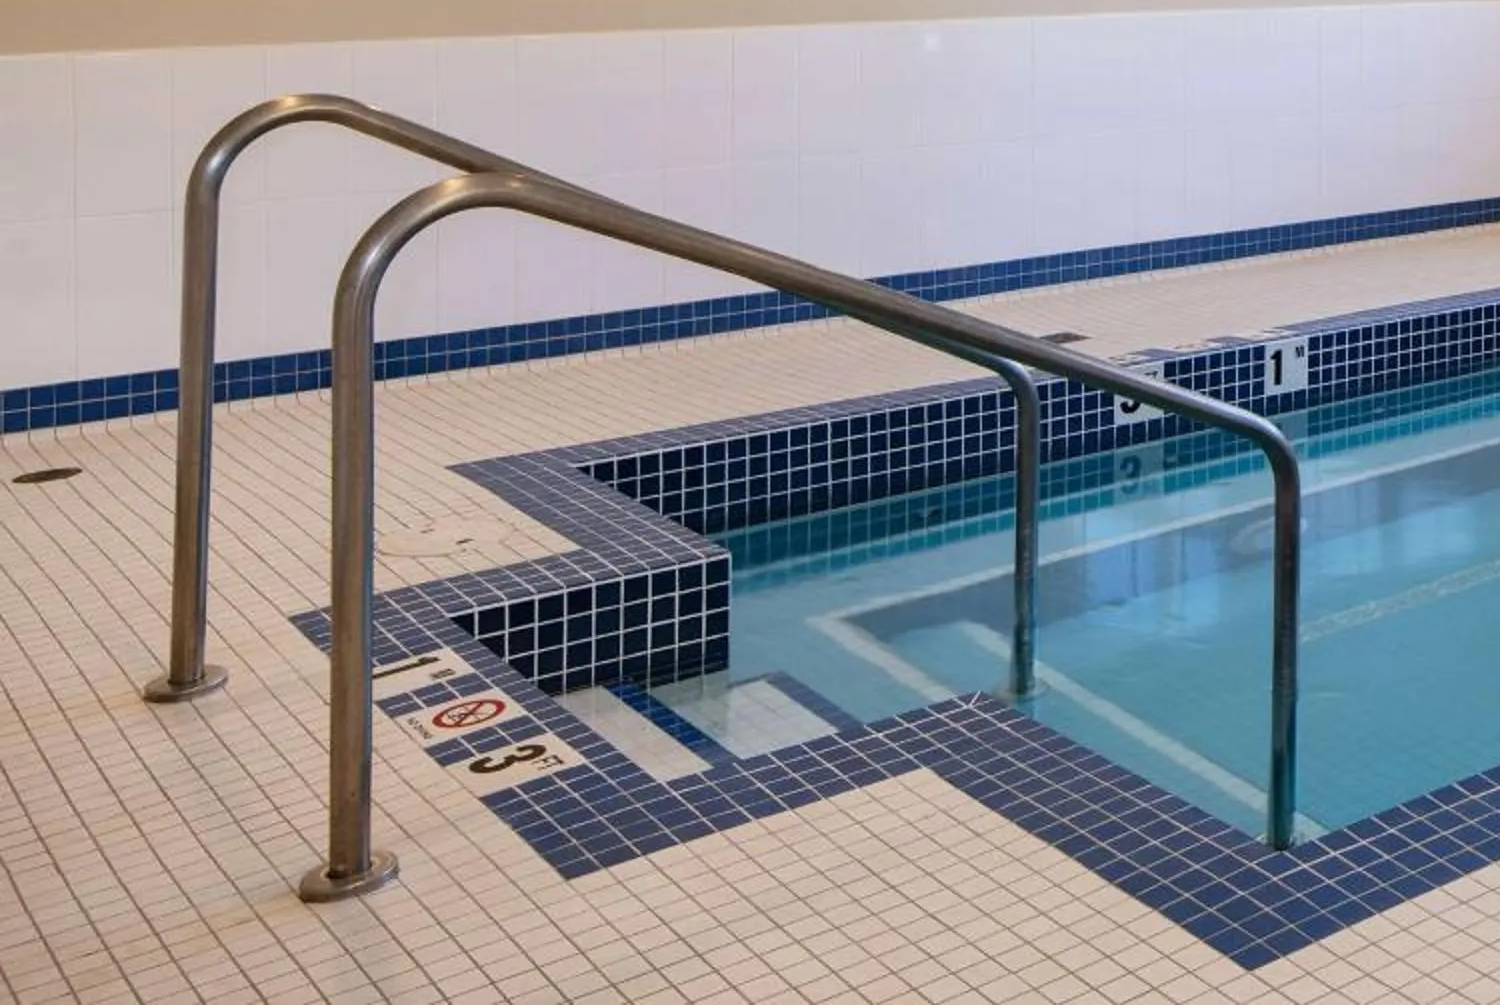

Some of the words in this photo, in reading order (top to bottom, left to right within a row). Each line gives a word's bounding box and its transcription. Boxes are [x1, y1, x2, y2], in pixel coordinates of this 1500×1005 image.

[1270, 348, 1282, 386] 1
[372, 655, 442, 680] 1
[469, 744, 547, 774] 3
[532, 754, 565, 772] FT
